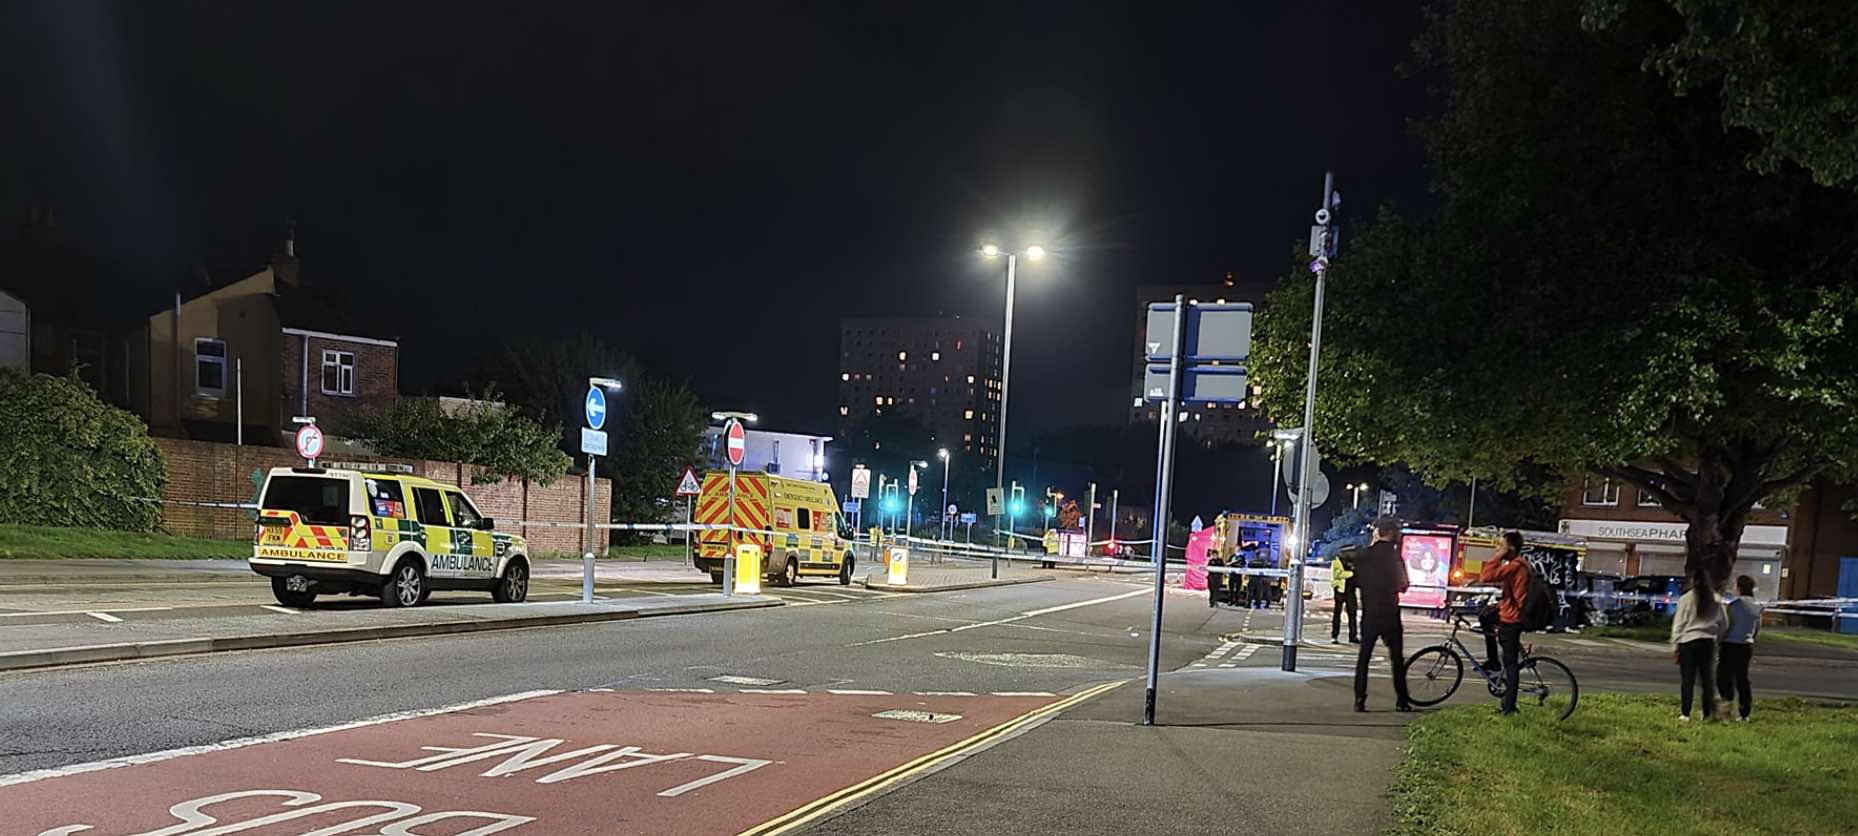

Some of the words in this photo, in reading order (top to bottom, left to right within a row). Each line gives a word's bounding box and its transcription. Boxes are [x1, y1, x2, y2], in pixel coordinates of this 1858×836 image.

[1598, 526, 1648, 538] SOUTHSEA
[1648, 528, 1688, 539] PHAR
[261, 548, 346, 561] AMBULANCE
[431, 554, 493, 572] AMBULANCE
[335, 732, 773, 797] LANE
